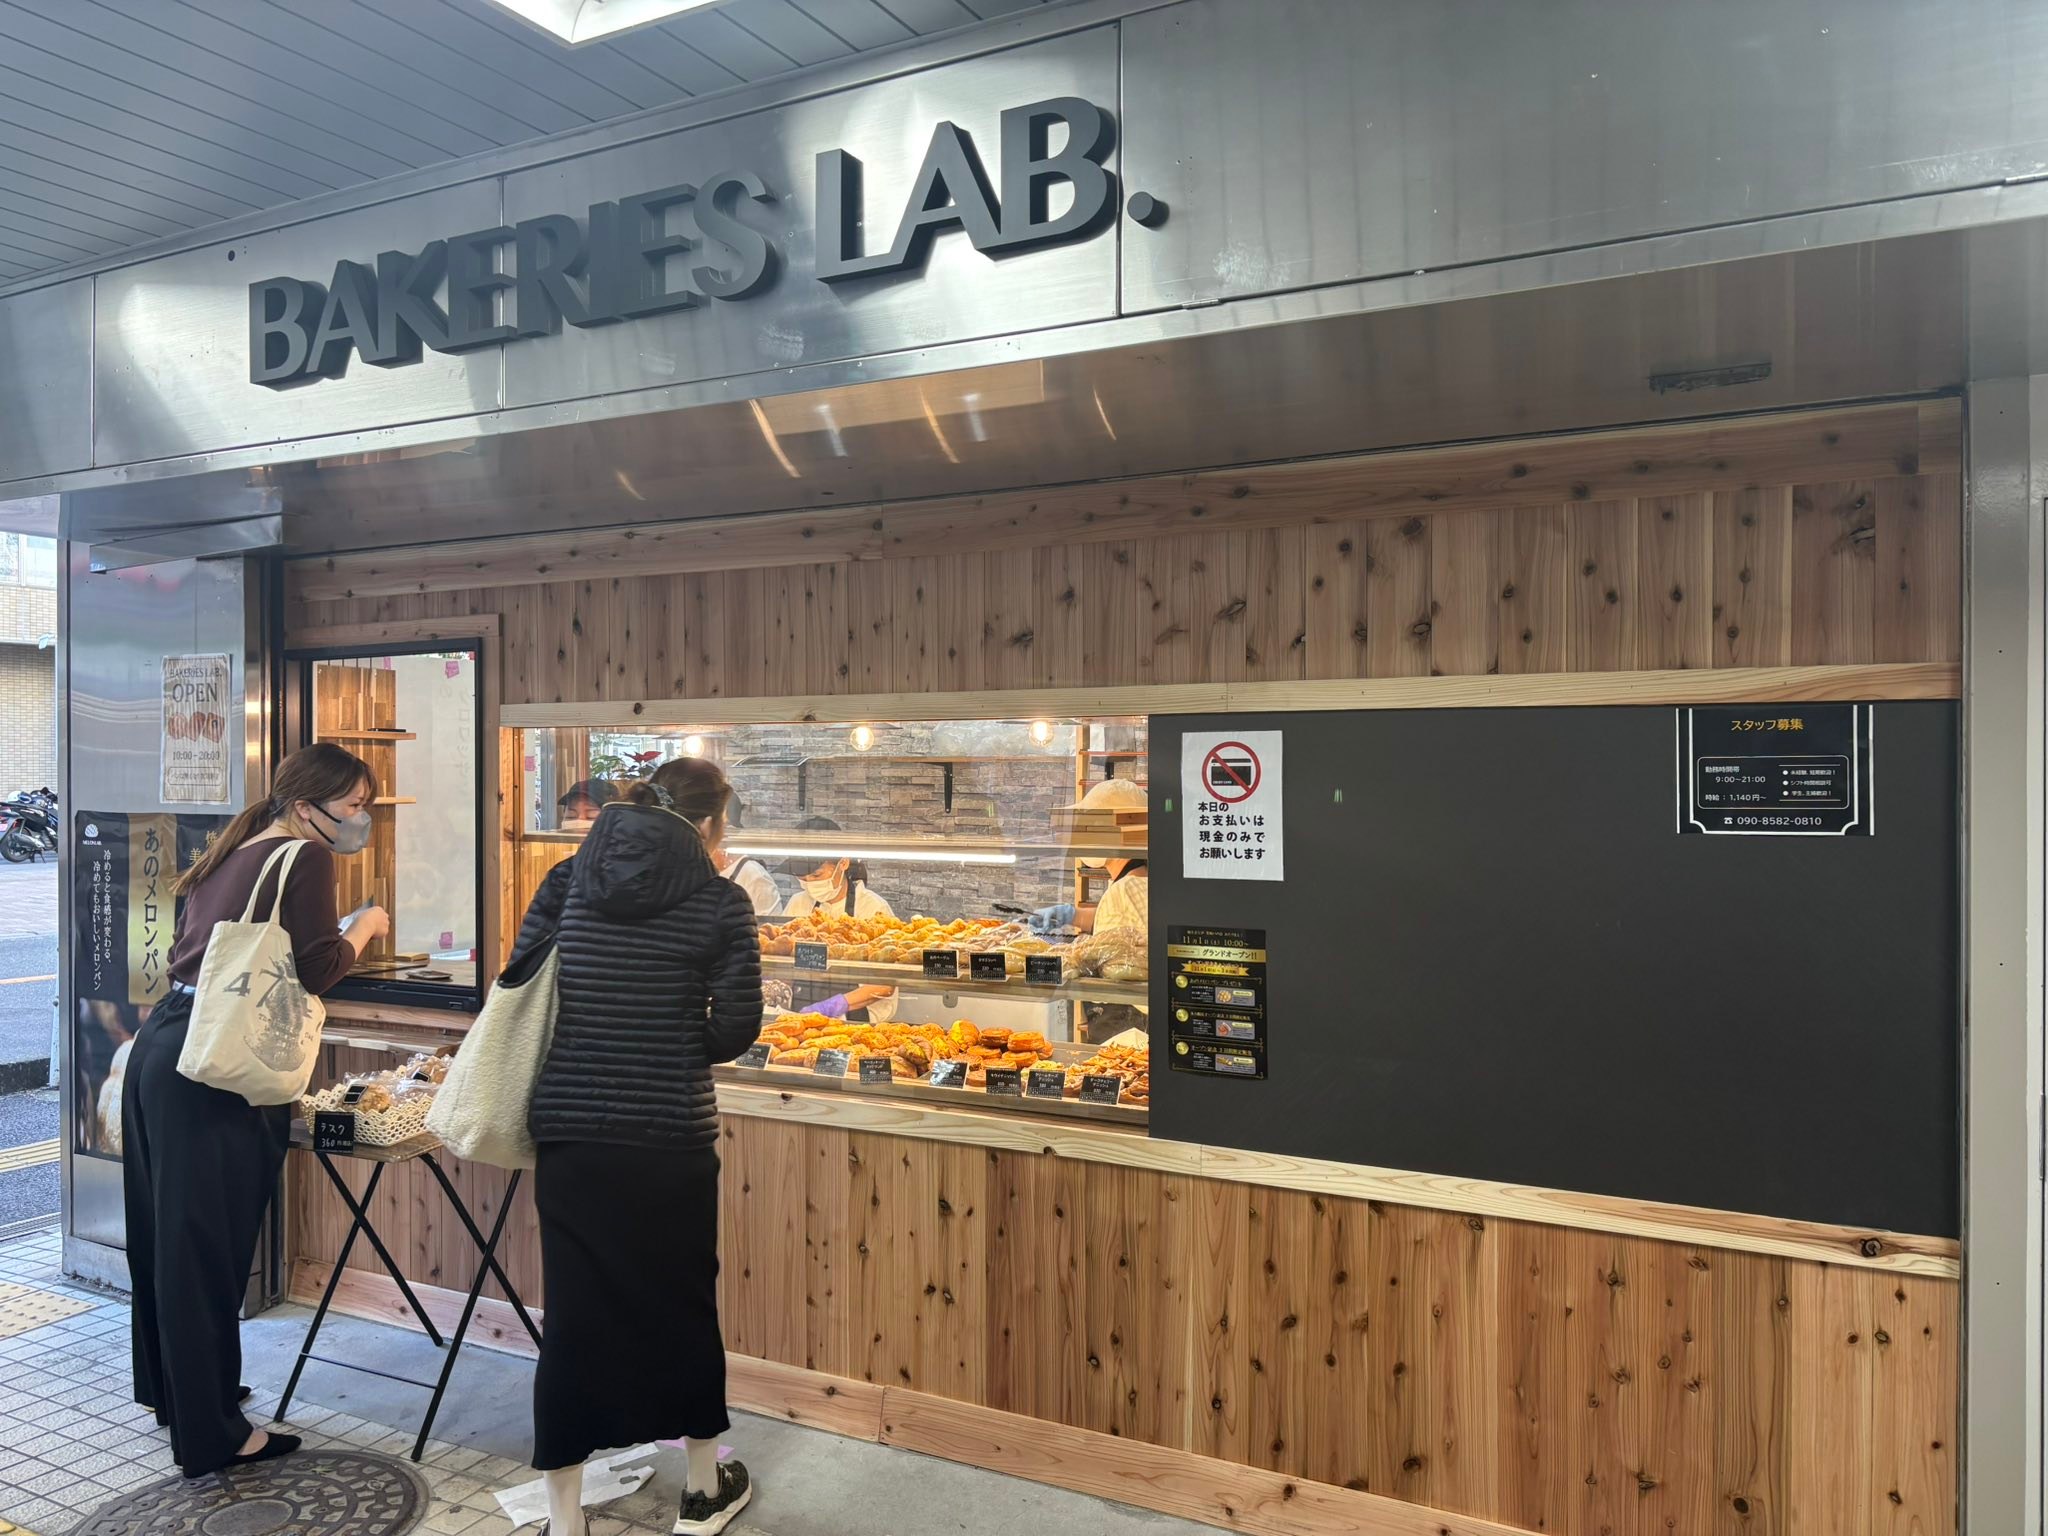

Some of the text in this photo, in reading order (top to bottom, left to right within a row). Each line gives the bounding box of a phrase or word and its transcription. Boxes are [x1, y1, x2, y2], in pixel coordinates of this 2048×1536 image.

[249, 97, 1169, 390] BAKERIES LAB.
[173, 682, 217, 702] OPEN
[1731, 718, 1804, 731] スタッフ募集
[1198, 802, 1229, 812] 本日の
[1199, 815, 1264, 826] お支払いは
[1737, 817, 1822, 825] 090-8582-0810
[1199, 831, 1265, 843] 現金のみで
[1199, 848, 1266, 860] お願いします
[103, 849, 112, 963] 冷めると食感が変わる、
[142, 827, 161, 994] あのメロンパン
[92, 861, 101, 991] 冷めてもおいしいメロンパン
[321, 1122, 345, 1135] ラスク
